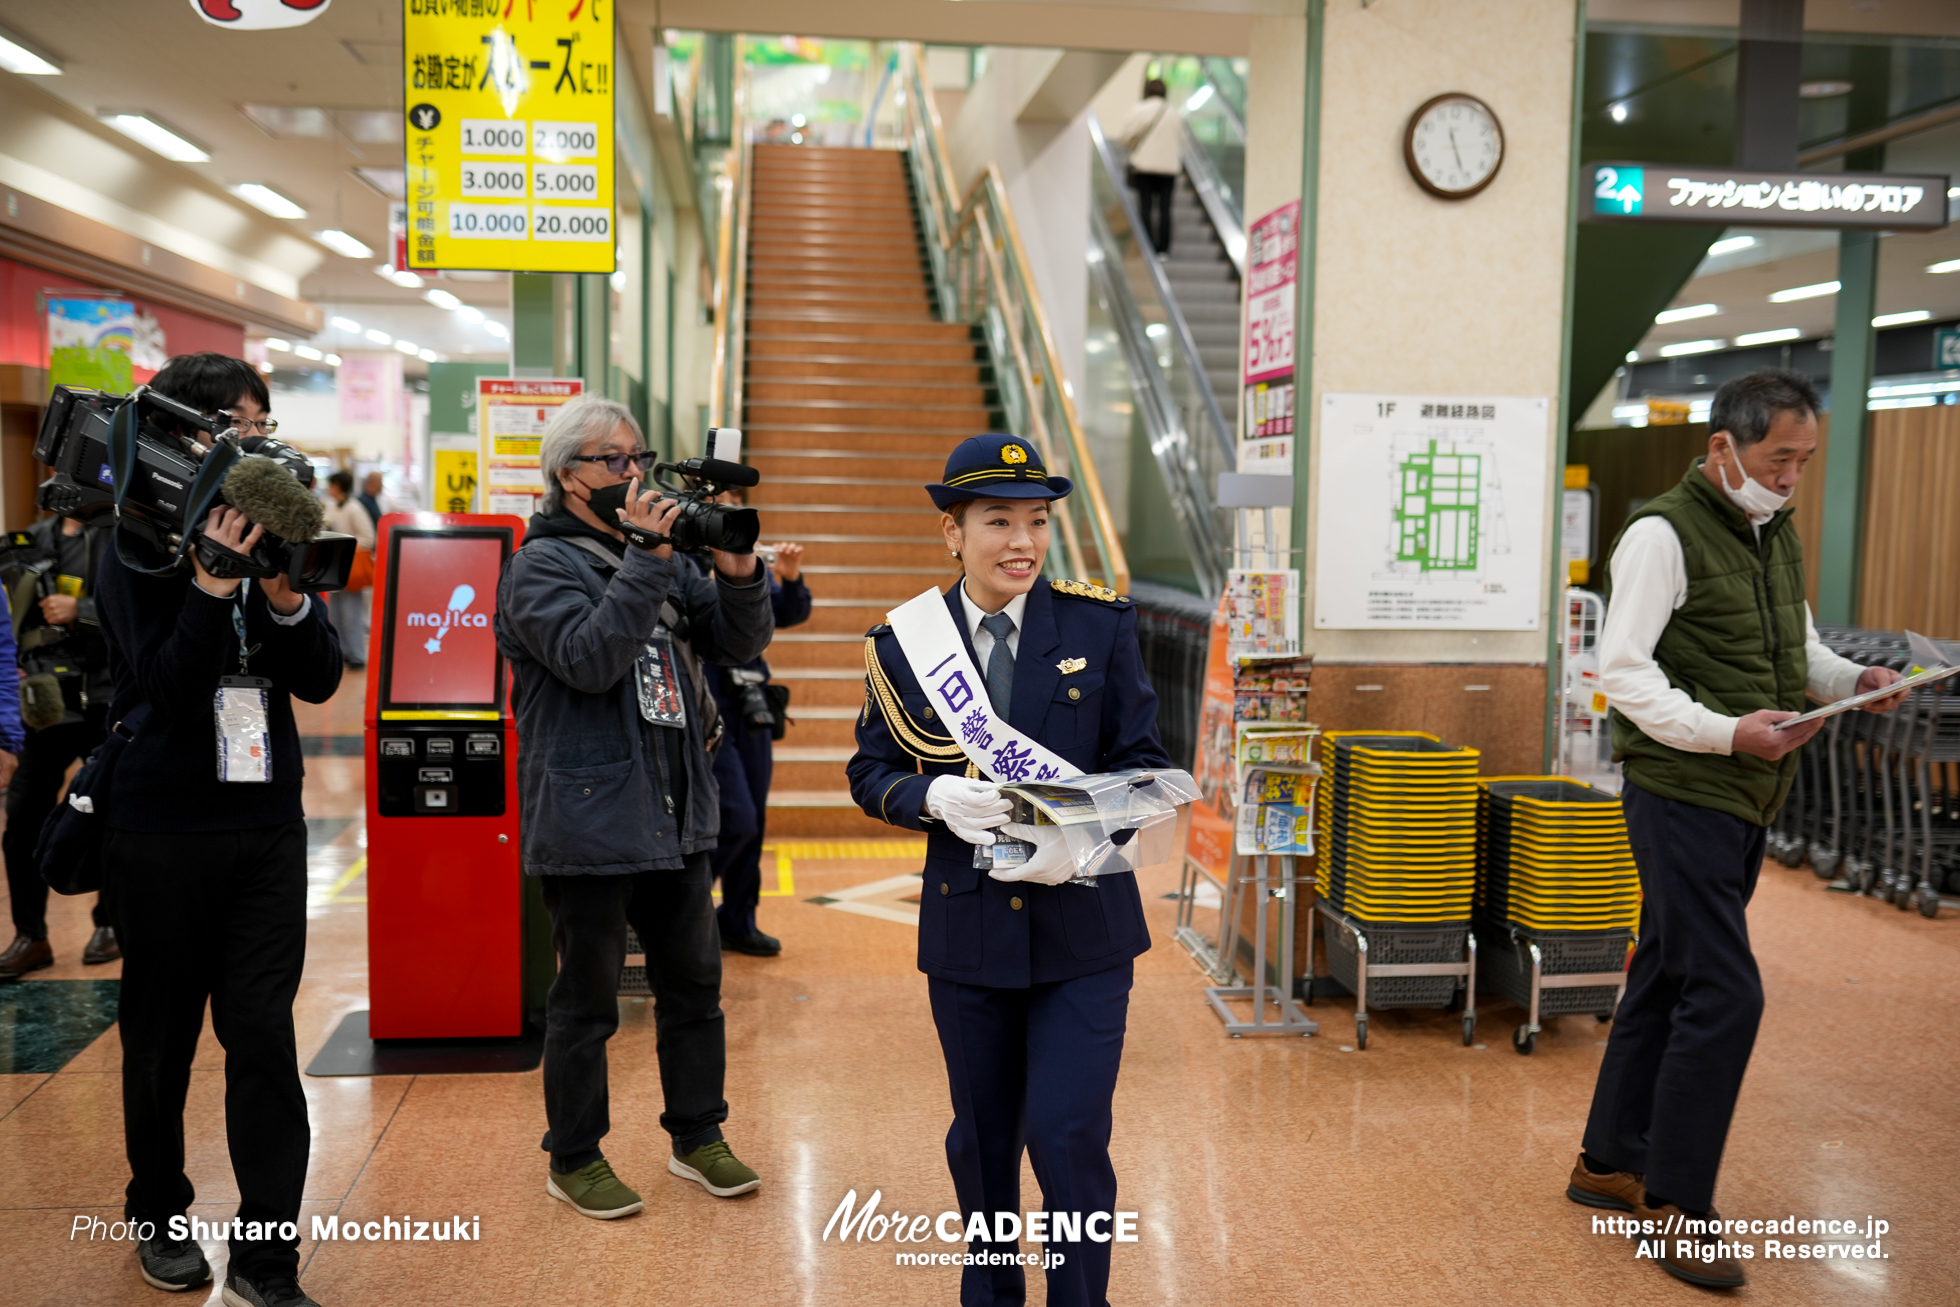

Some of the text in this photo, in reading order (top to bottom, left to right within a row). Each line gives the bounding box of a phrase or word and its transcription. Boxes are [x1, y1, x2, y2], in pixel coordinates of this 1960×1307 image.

[463, 128, 596, 150] 1.000 2.000
[463, 171, 596, 192] 3.000 5.000
[1594, 167, 1619, 199] 2
[452, 213, 609, 235] 10.000 20.000
[1377, 402, 1496, 420] 1F 避難経路図
[151, 471, 184, 490] Panasonic
[629, 532, 645, 544] JVC
